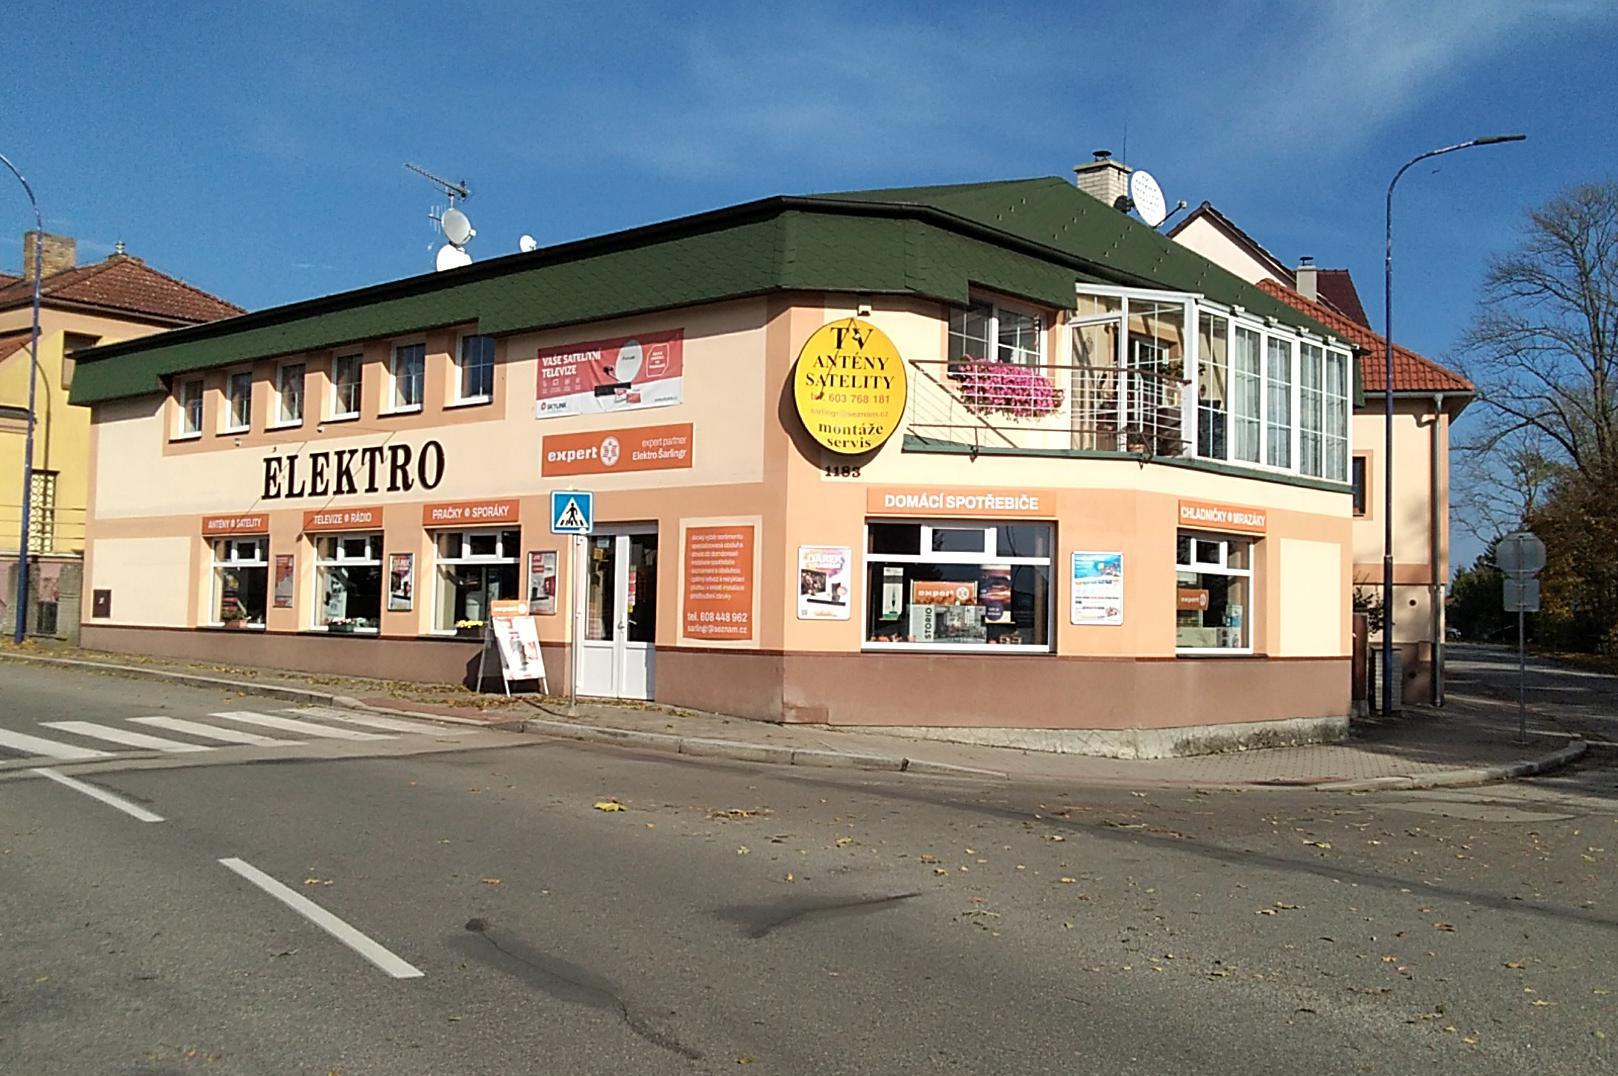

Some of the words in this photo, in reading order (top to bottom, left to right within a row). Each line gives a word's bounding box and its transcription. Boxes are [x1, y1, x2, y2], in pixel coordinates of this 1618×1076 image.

[831, 327, 873, 350] TV
[542, 353, 561, 366] VAŠE
[813, 352, 889, 371] ANTÉNY
[542, 365, 577, 378] TELEVIZE
[805, 373, 894, 390] SATELITY
[829, 393, 847, 403] 603
[852, 394, 869, 404] 768
[874, 395, 890, 404] 181
[818, 422, 884, 435] montáže
[827, 437, 872, 448] servis
[548, 446, 597, 463] expert
[632, 450, 657, 461] Elektro
[261, 440, 446, 500] ELEKTRO
[825, 466, 861, 478] 1183
[884, 493, 943, 509] DOMÁCÍ
[946, 494, 1039, 510] SPOTŘEBIČE
[314, 513, 343, 524] TELEVIZE
[351, 511, 372, 523] RÁDIO
[432, 506, 463, 519] PRAČKY
[471, 504, 509, 518] SPORÁKY
[687, 611, 699, 622] tel.
[731, 612, 748, 623] 962
[924, 607, 933, 640] STORIO
